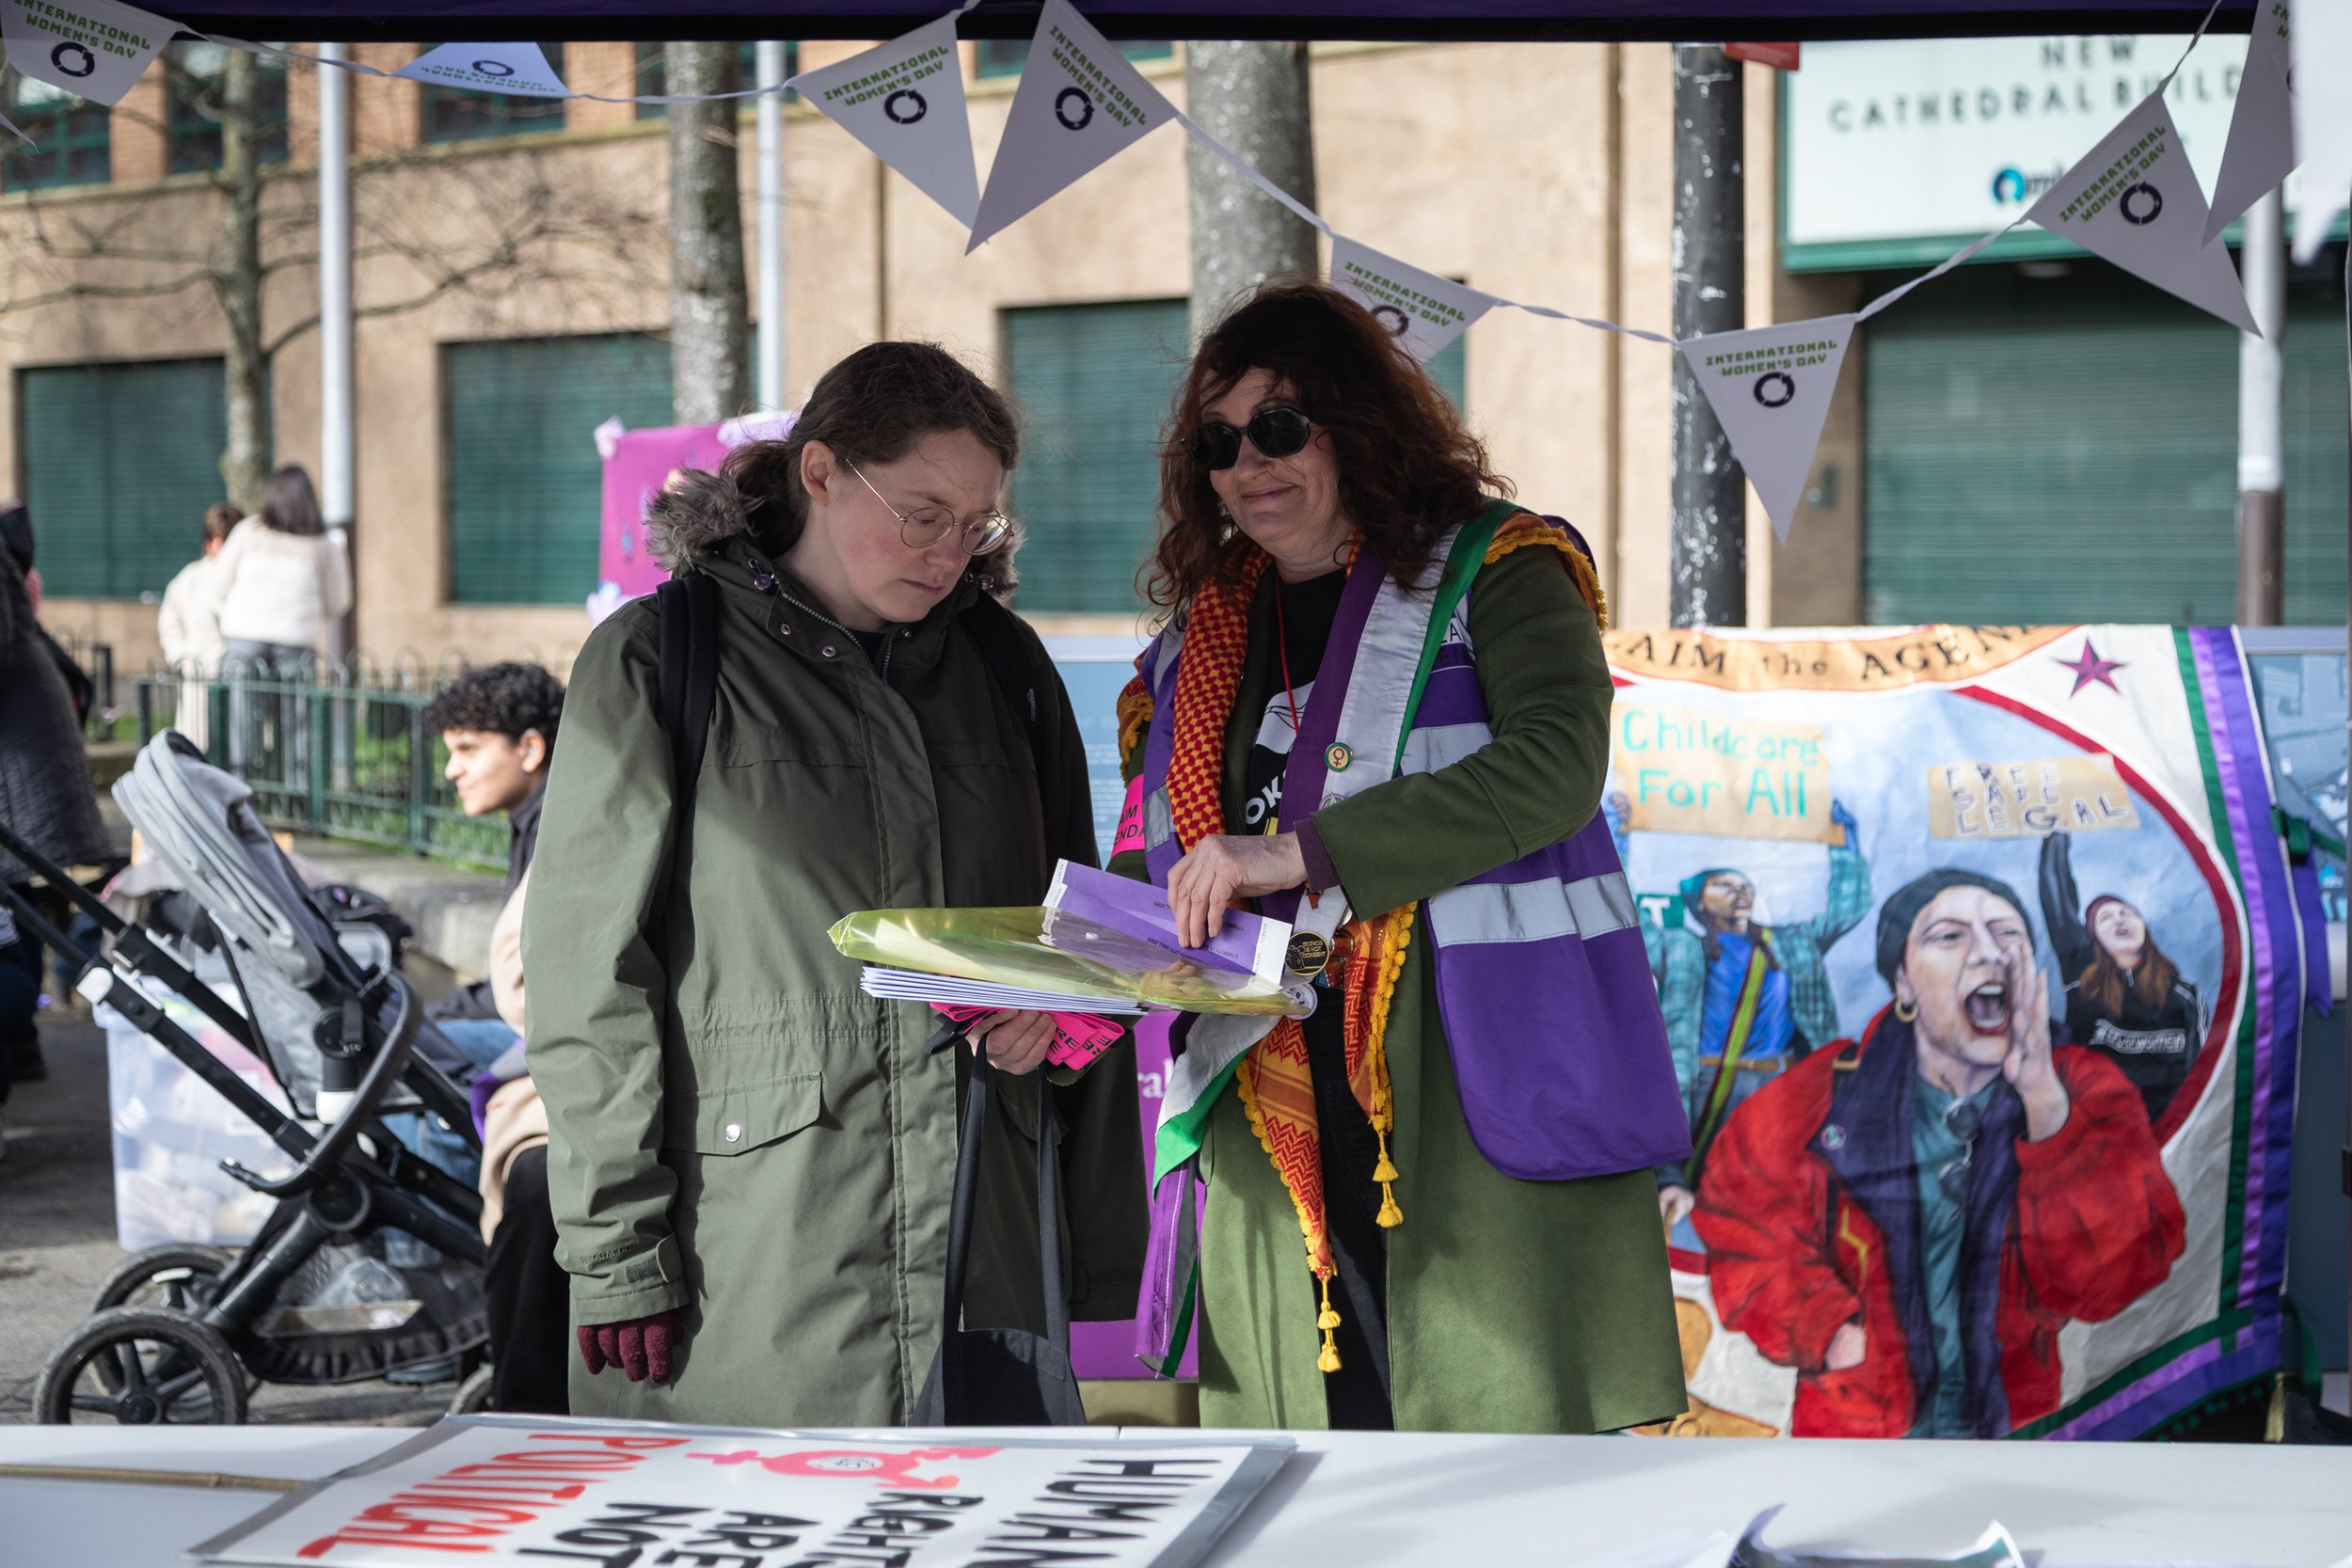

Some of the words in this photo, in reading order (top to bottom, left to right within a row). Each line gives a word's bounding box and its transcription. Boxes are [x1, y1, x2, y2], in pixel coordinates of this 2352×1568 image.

[14, 0, 151, 51] INTERNATIONAL
[26, 13, 99, 48] WOMEN'S
[103, 40, 136, 59] DAY
[823, 46, 949, 101] INTERNATIONAL
[1049, 24, 1147, 126] INTERNATIONAL
[2042, 36, 2137, 69] NEW
[844, 74, 912, 106] WOMEN'S
[914, 61, 945, 81] DAY
[1052, 47, 1106, 103] WOMEN'S
[1105, 101, 1133, 128] DAY
[1829, 79, 2093, 133] CATHEDRAL
[2058, 125, 2167, 223] INTERNATIONAL
[2080, 166, 2140, 223] WOMEN'S
[2138, 142, 2167, 170] DAY
[1343, 261, 1466, 322] INTERNATIONAL
[1352, 278, 1419, 313] WOMEN'S
[1420, 308, 1451, 327] DAY
[1705, 339, 1838, 367] INTERNATIONAL
[1721, 358, 1792, 376] WOMEN'S
[1795, 354, 1828, 368] DAY
[1761, 652, 1829, 676] the
[1622, 709, 1820, 768] Childcare
[1638, 768, 1724, 809] For
[1745, 768, 1806, 818] All
[1956, 794, 2129, 835] LEGAL
[296, 1433, 692, 1560] POLITICAL
